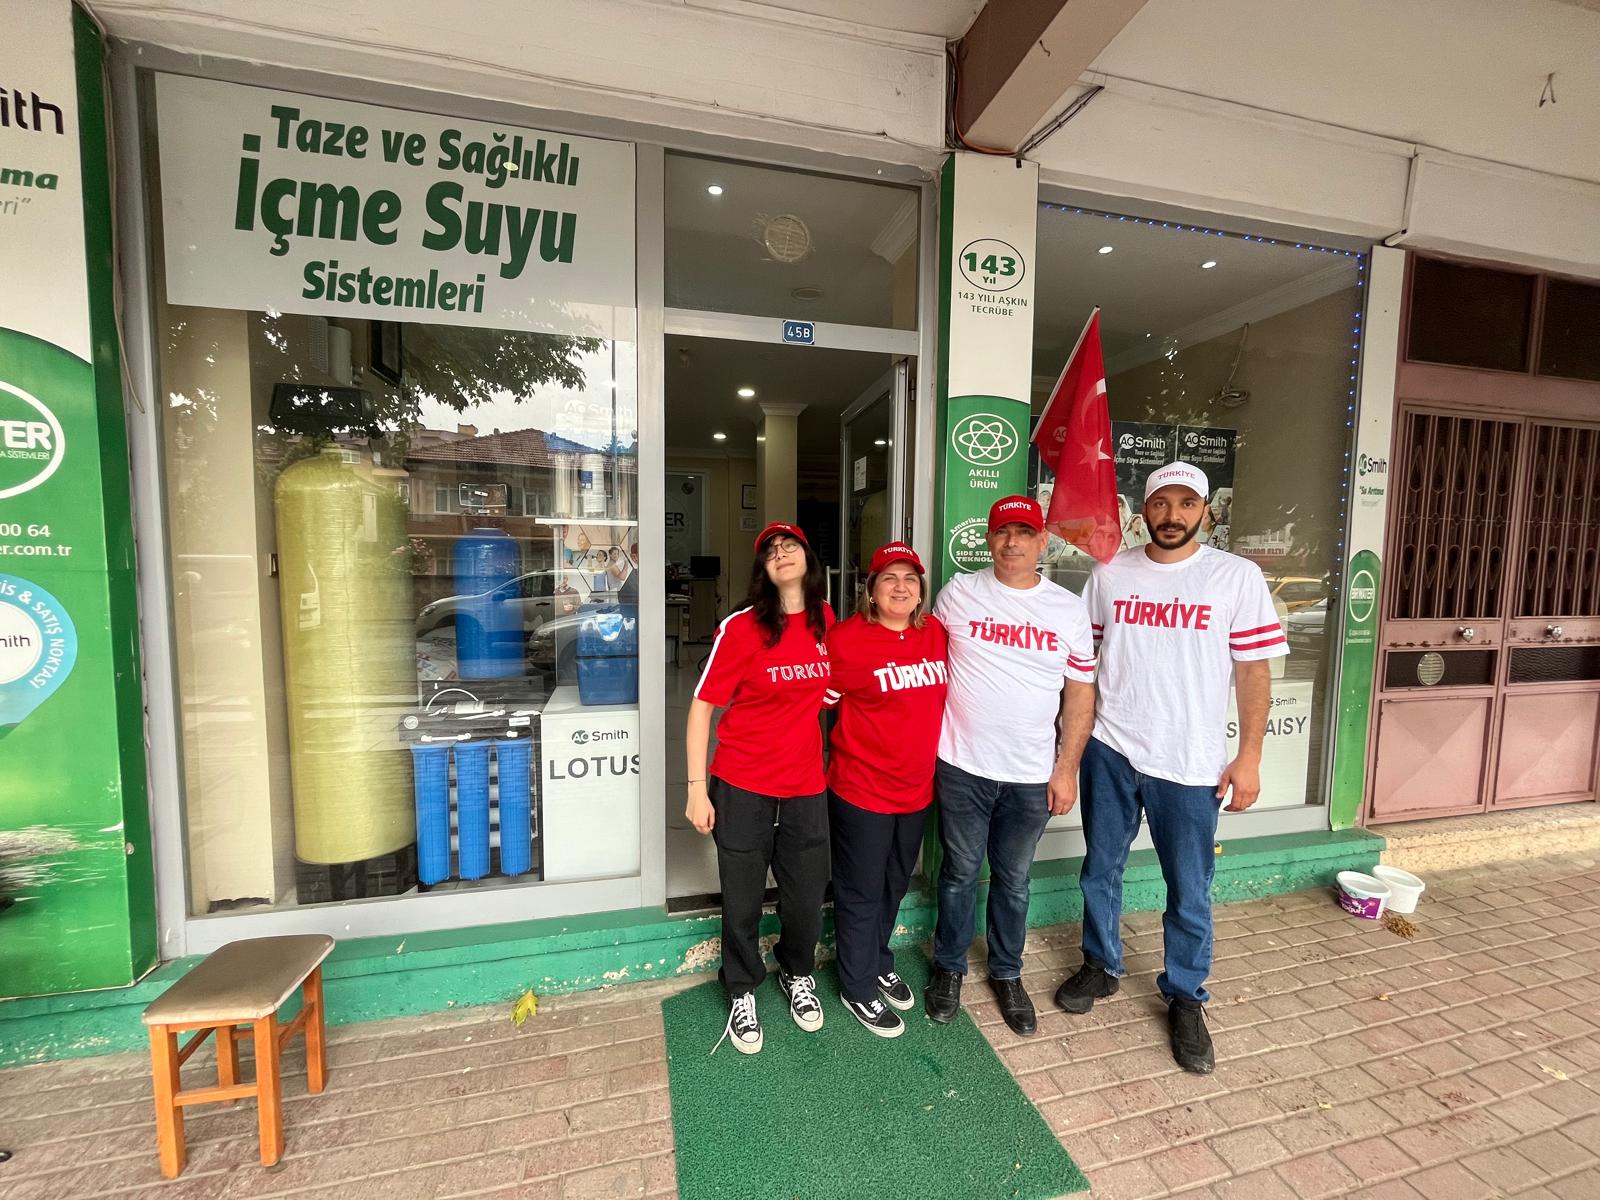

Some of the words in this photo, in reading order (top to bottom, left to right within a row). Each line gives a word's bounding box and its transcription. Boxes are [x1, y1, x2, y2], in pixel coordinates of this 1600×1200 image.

[270, 104, 369, 159] Taze
[381, 129, 427, 166] ve
[437, 128, 580, 189] Sağlıklı
[234, 133, 401, 257] İçme
[421, 180, 577, 280] Suyu
[963, 252, 1016, 276] 143
[302, 259, 486, 314] Sistemleri
[958, 291, 975, 300] 143
[977, 293, 996, 303] YILI
[998, 296, 1028, 307] AŞKIN
[971, 305, 1014, 316] TECRÜBE
[787, 325, 811, 339] 45B
[0, 420, 52, 450] ER
[1135, 437, 1166, 449] Smith
[1199, 435, 1227, 447] Smith
[968, 469, 1000, 478] AKILLI
[969, 479, 998, 489] ÜRÜN
[0, 523, 22, 536] 00
[27, 524, 52, 537] 64
[0, 544, 73, 556] r.com.tr
[0, 580, 16, 596] İS
[18, 590, 32, 604] &
[31, 601, 63, 635] SATIŞ
[1113, 595, 1212, 631] TÜRKİYE
[968, 617, 1058, 652] TÜRKİYE
[29, 638, 65, 689] NOKTASI
[1275, 697, 1297, 706] Smith
[1264, 716, 1307, 736] AISY
[591, 729, 629, 741] Smith
